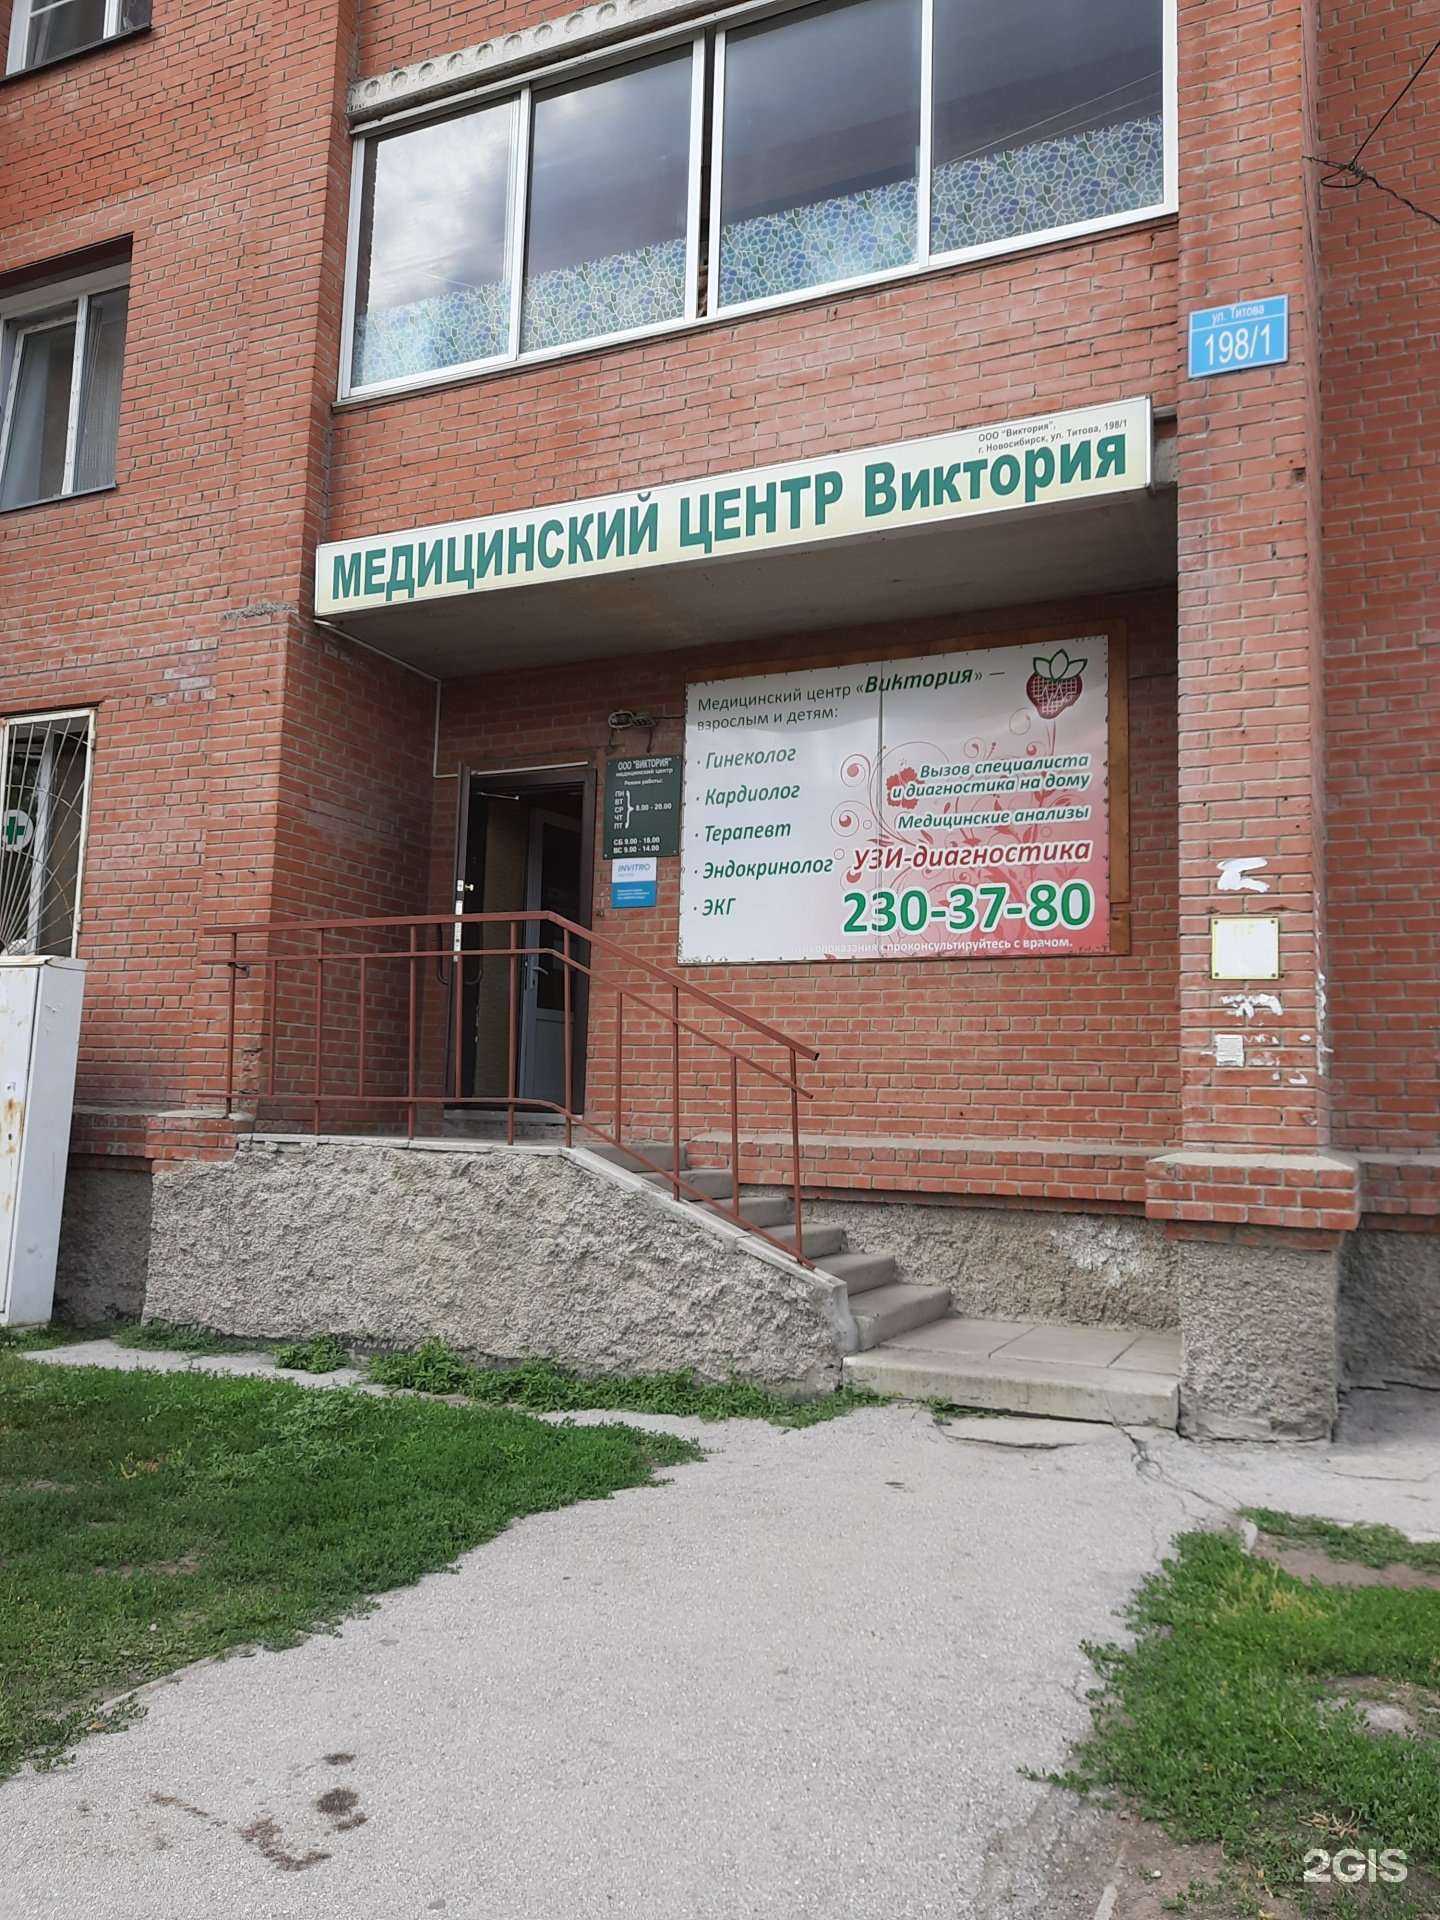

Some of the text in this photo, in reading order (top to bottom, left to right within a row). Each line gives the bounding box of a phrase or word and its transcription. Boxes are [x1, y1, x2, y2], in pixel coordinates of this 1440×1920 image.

[1212, 304, 1265, 326] ул. Титова
[1205, 323, 1270, 366] 198/1
[978, 431, 999, 442] ООО
[978, 419, 1127, 454] г. Новосибирск, ул. Титова, 198/1
[332, 434, 1126, 601] МЕДИЦИНСКИЙ ЦЕНТР Виктория
[698, 688, 802, 711] Медицинский
[807, 684, 851, 702] центр
[856, 668, 983, 694] «Виктория»
[697, 708, 839, 732] взрослым и детям:
[617, 757, 672, 770] ООО "ВИКТОРИЯ"
[705, 747, 797, 770] Гинеколог
[920, 756, 1089, 778] Вызов специалиста
[704, 784, 801, 808] Кардиолог
[893, 773, 1090, 799] и диагностика на дому
[614, 806, 624, 814] СР
[614, 814, 624, 822] ЧТ
[898, 807, 1089, 830] Медицинские анализы
[613, 822, 624, 830] ПТ
[705, 822, 792, 845] Терапевт
[617, 863, 651, 872] INVITRO
[854, 842, 1091, 870] УЗИ-диагностика
[702, 857, 834, 880] Эндокринолог
[702, 896, 737, 917] ЭКГ
[843, 883, 1092, 933] 230-37-80
[1013, 940, 1020, 949] с
[1023, 938, 1073, 951] врачом.
